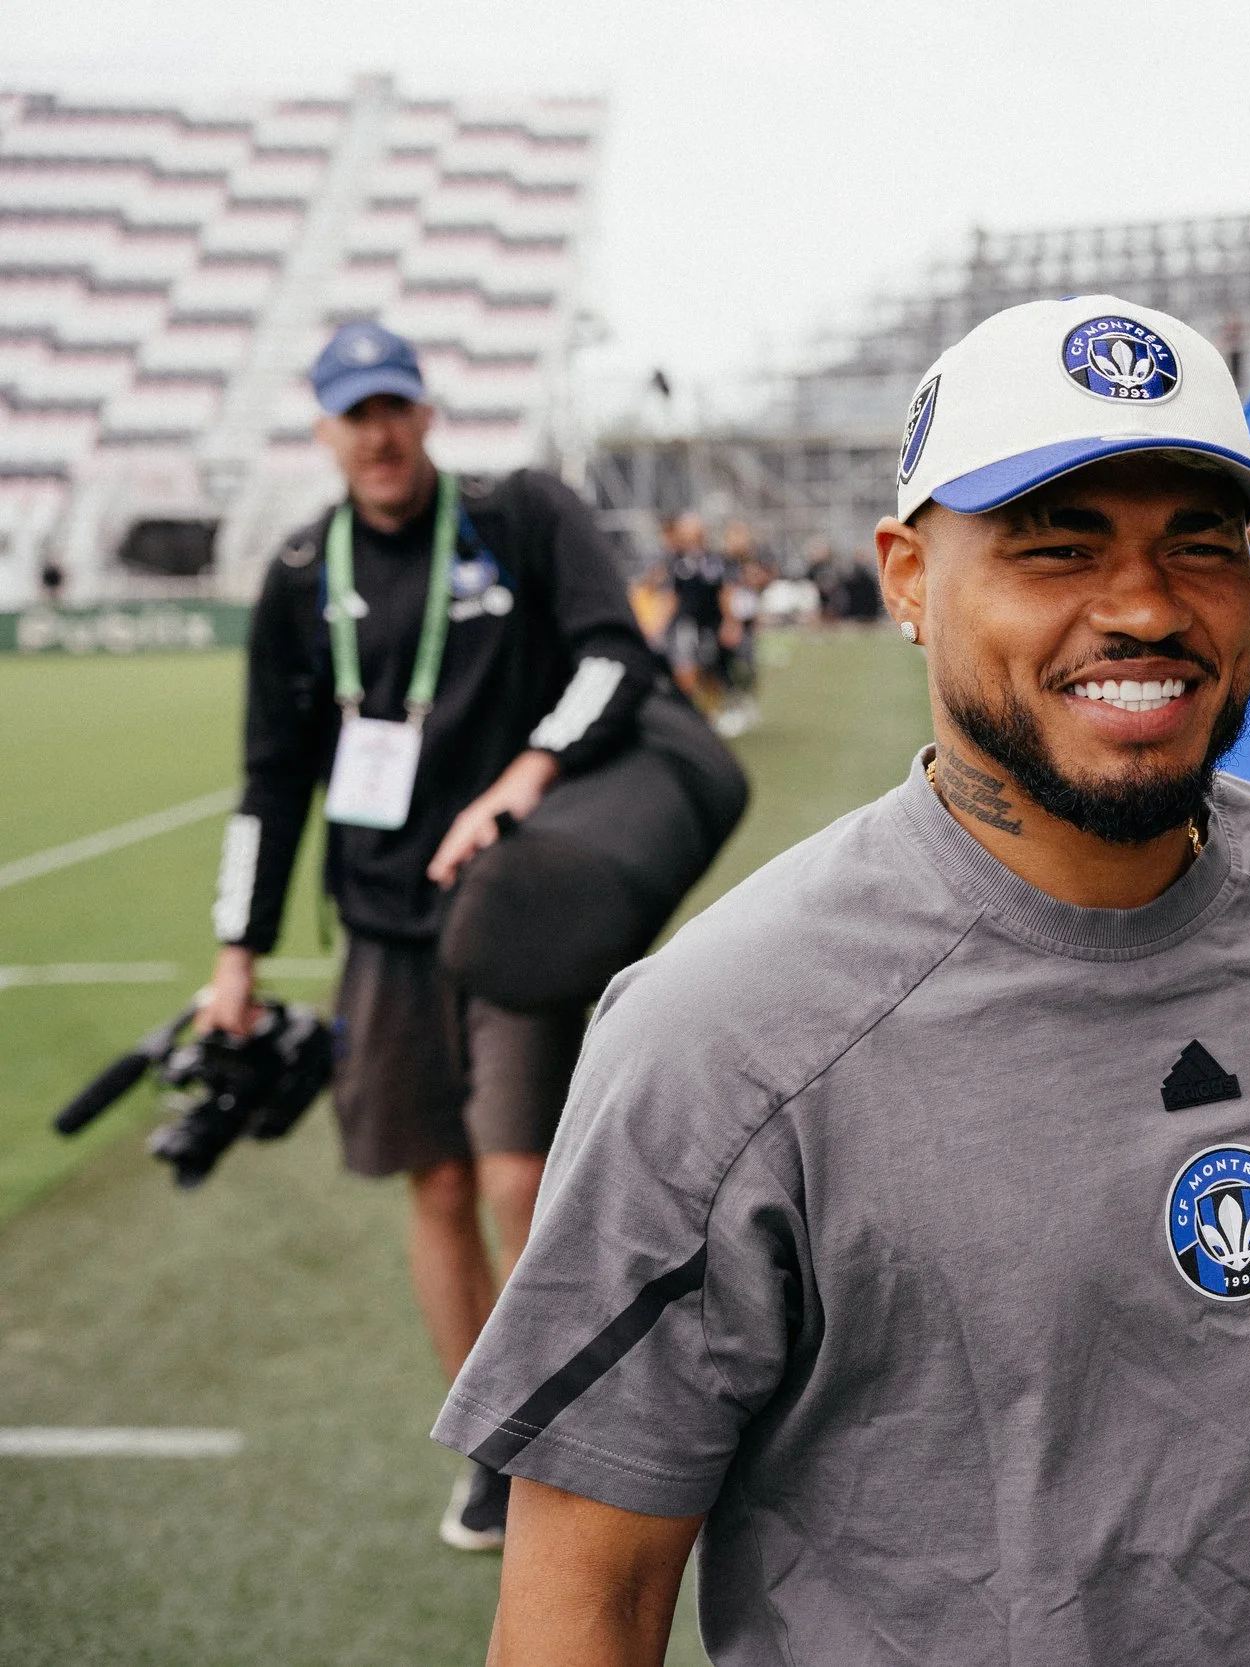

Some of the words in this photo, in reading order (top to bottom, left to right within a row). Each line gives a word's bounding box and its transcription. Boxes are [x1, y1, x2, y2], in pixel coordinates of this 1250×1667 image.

[1070, 337, 1085, 356] CF
[1108, 386, 1151, 399] 1993
[1177, 1198, 1190, 1227] CF
